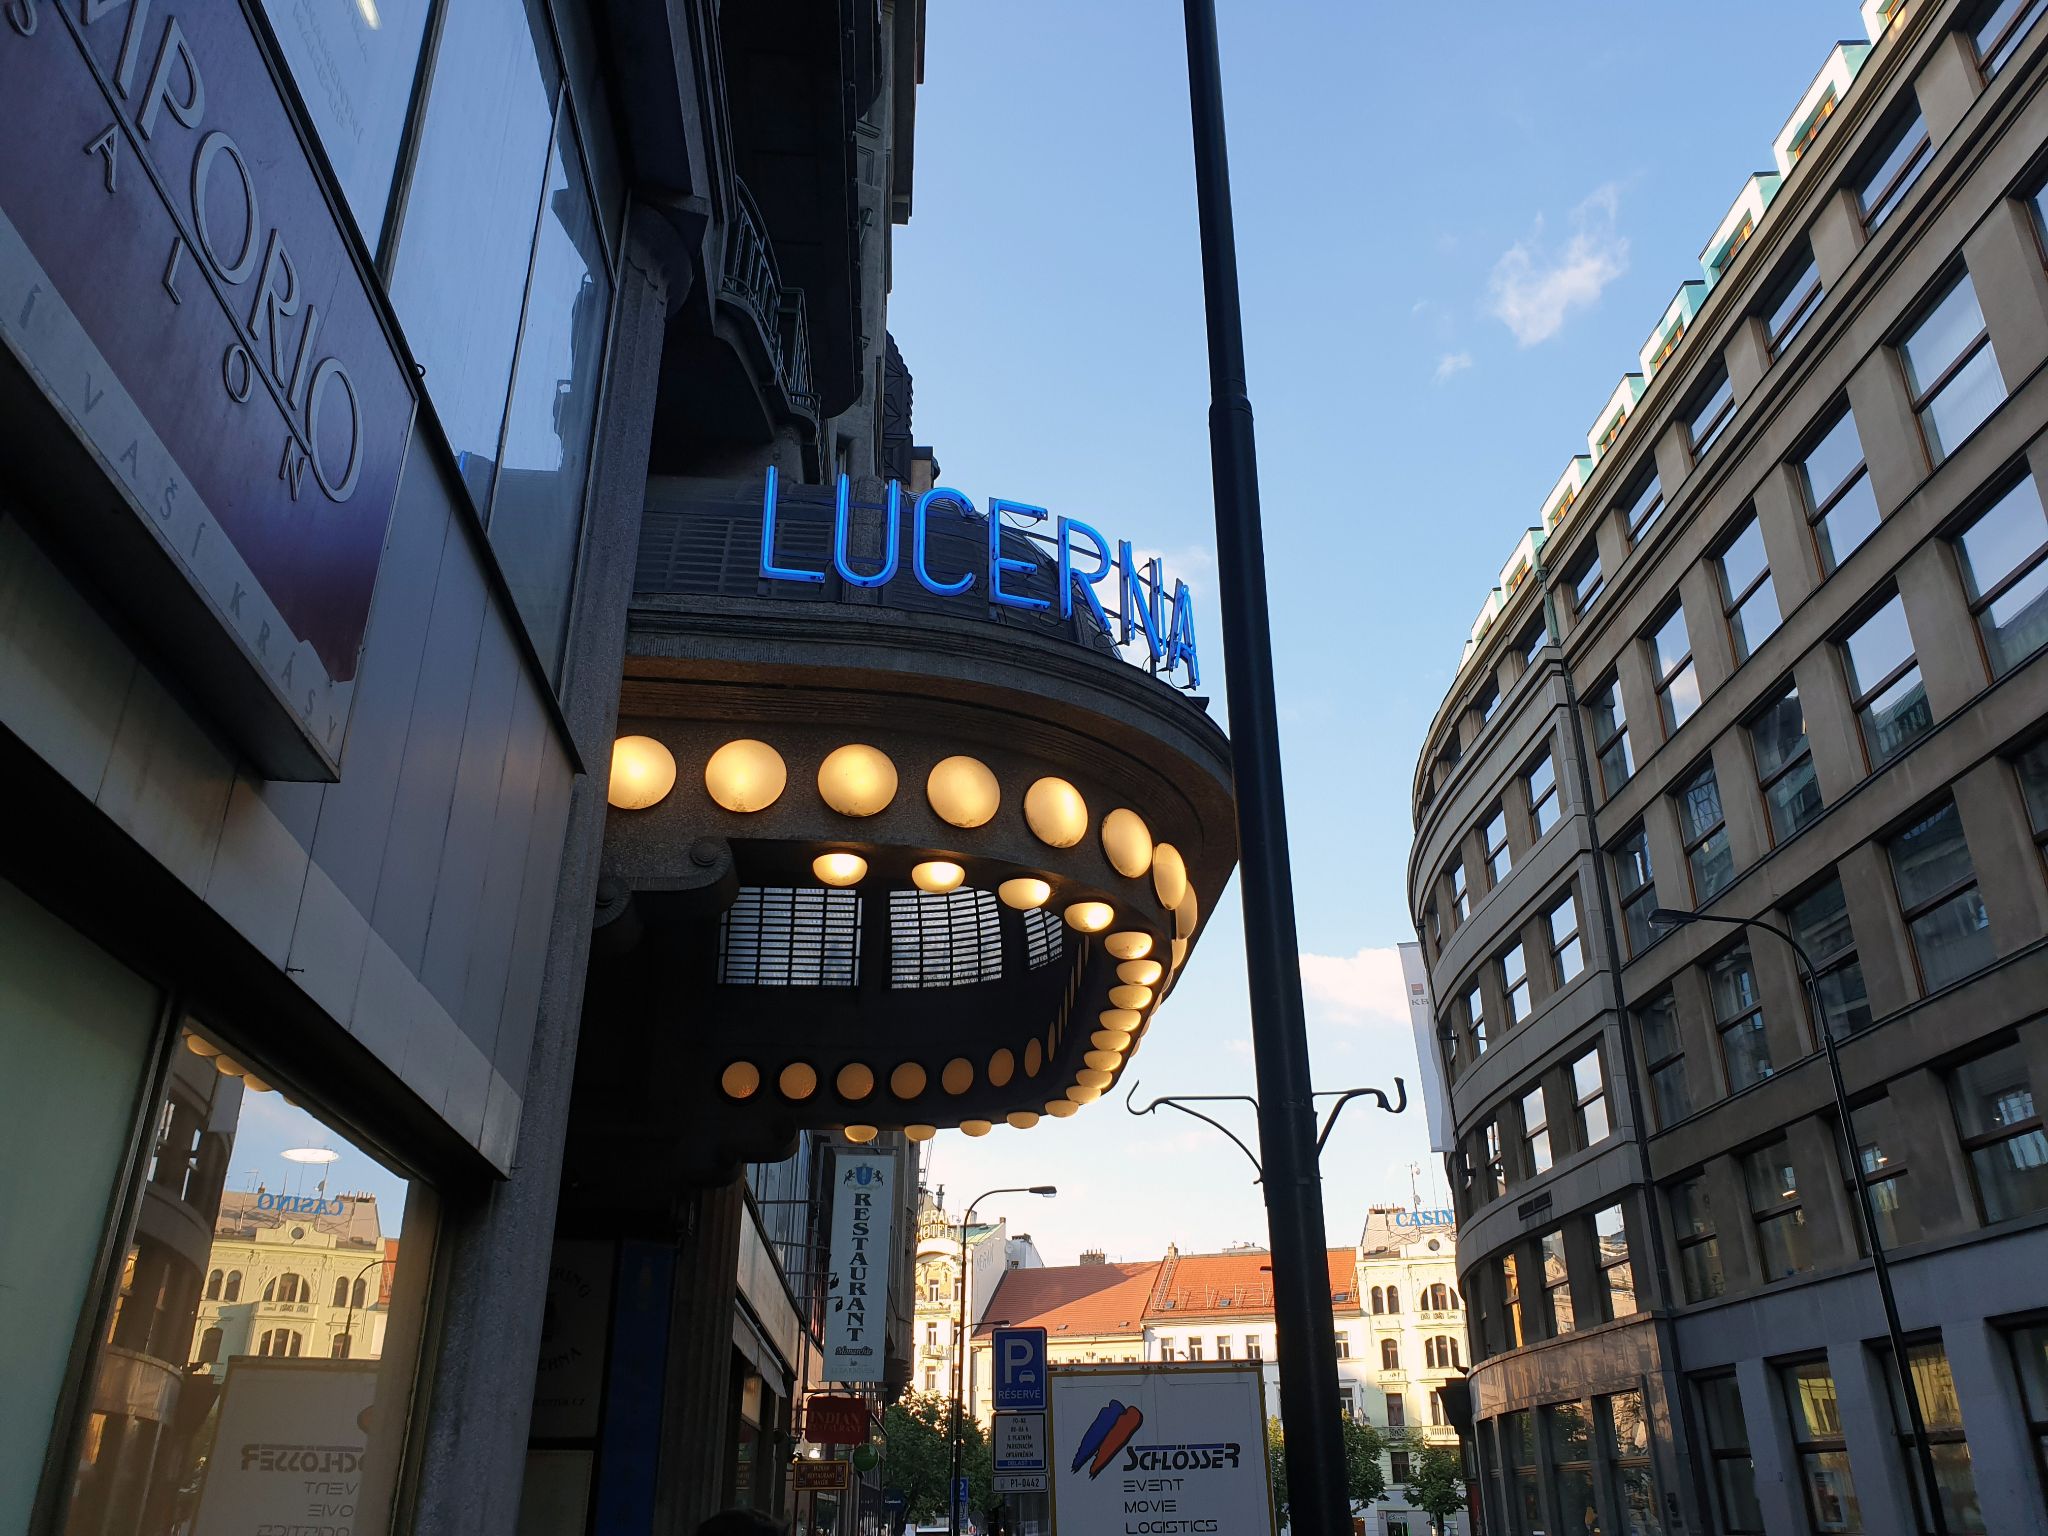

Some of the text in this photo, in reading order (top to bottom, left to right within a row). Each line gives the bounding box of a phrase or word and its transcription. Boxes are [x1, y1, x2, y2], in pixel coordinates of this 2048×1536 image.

[759, 465, 1202, 691] LUCERNA
[227, 581, 338, 744] KRÁSY
[1395, 1209, 1454, 1227] CASIN
[845, 1192, 872, 1342] RESTAURANT
[1003, 1338, 1034, 1384] P
[810, 1410, 861, 1425] INDIAN
[1123, 1442, 1241, 1471] SCHLÖSSER
[1123, 1478, 1185, 1492] EVENT
[1124, 1499, 1177, 1513] MOVIE
[1125, 1519, 1218, 1535] LOGISTICS
